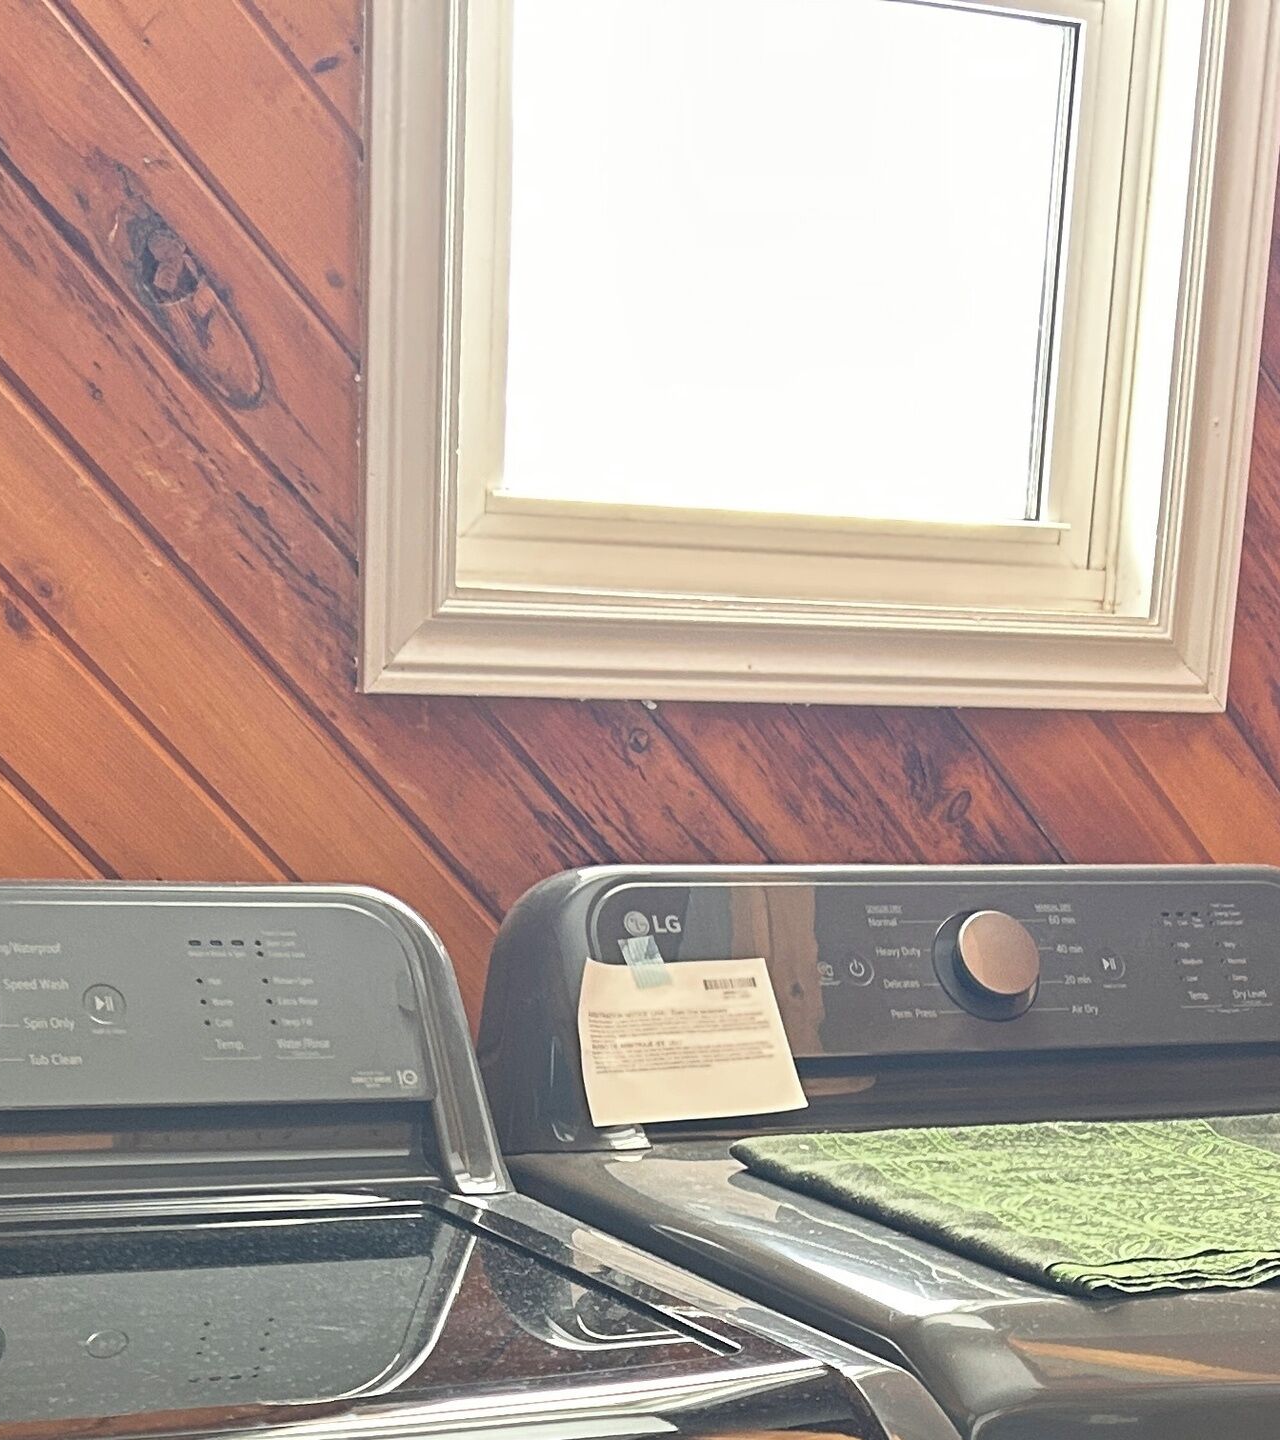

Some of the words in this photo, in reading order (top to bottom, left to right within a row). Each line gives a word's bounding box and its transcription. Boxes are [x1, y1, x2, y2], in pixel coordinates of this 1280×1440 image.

[652, 914, 681, 933] LG
[867, 917, 898, 927] Normal
[1048, 915, 1059, 925] 60
[1061, 916, 1076, 925] min
[876, 947, 900, 958] Heavy
[901, 947, 921, 957] Duty
[1056, 944, 1068, 954] 40
[1069, 944, 1083, 954] min
[883, 978, 921, 989] Delicates
[1064, 975, 1076, 985] 20
[1077, 974, 1092, 985] min
[3, 979, 38, 992] Speed
[39, 979, 69, 991] Wash
[1232, 989, 1247, 1000] Dry
[1248, 989, 1267, 999] Level
[916, 1008, 938, 1019] Press
[1072, 1005, 1083, 1014] Air
[1084, 1004, 1099, 1016] Dry
[23, 1017, 48, 1031] Spin
[50, 1017, 75, 1032] Only
[28, 1054, 49, 1065] Tub
[51, 1053, 83, 1065] Clean
